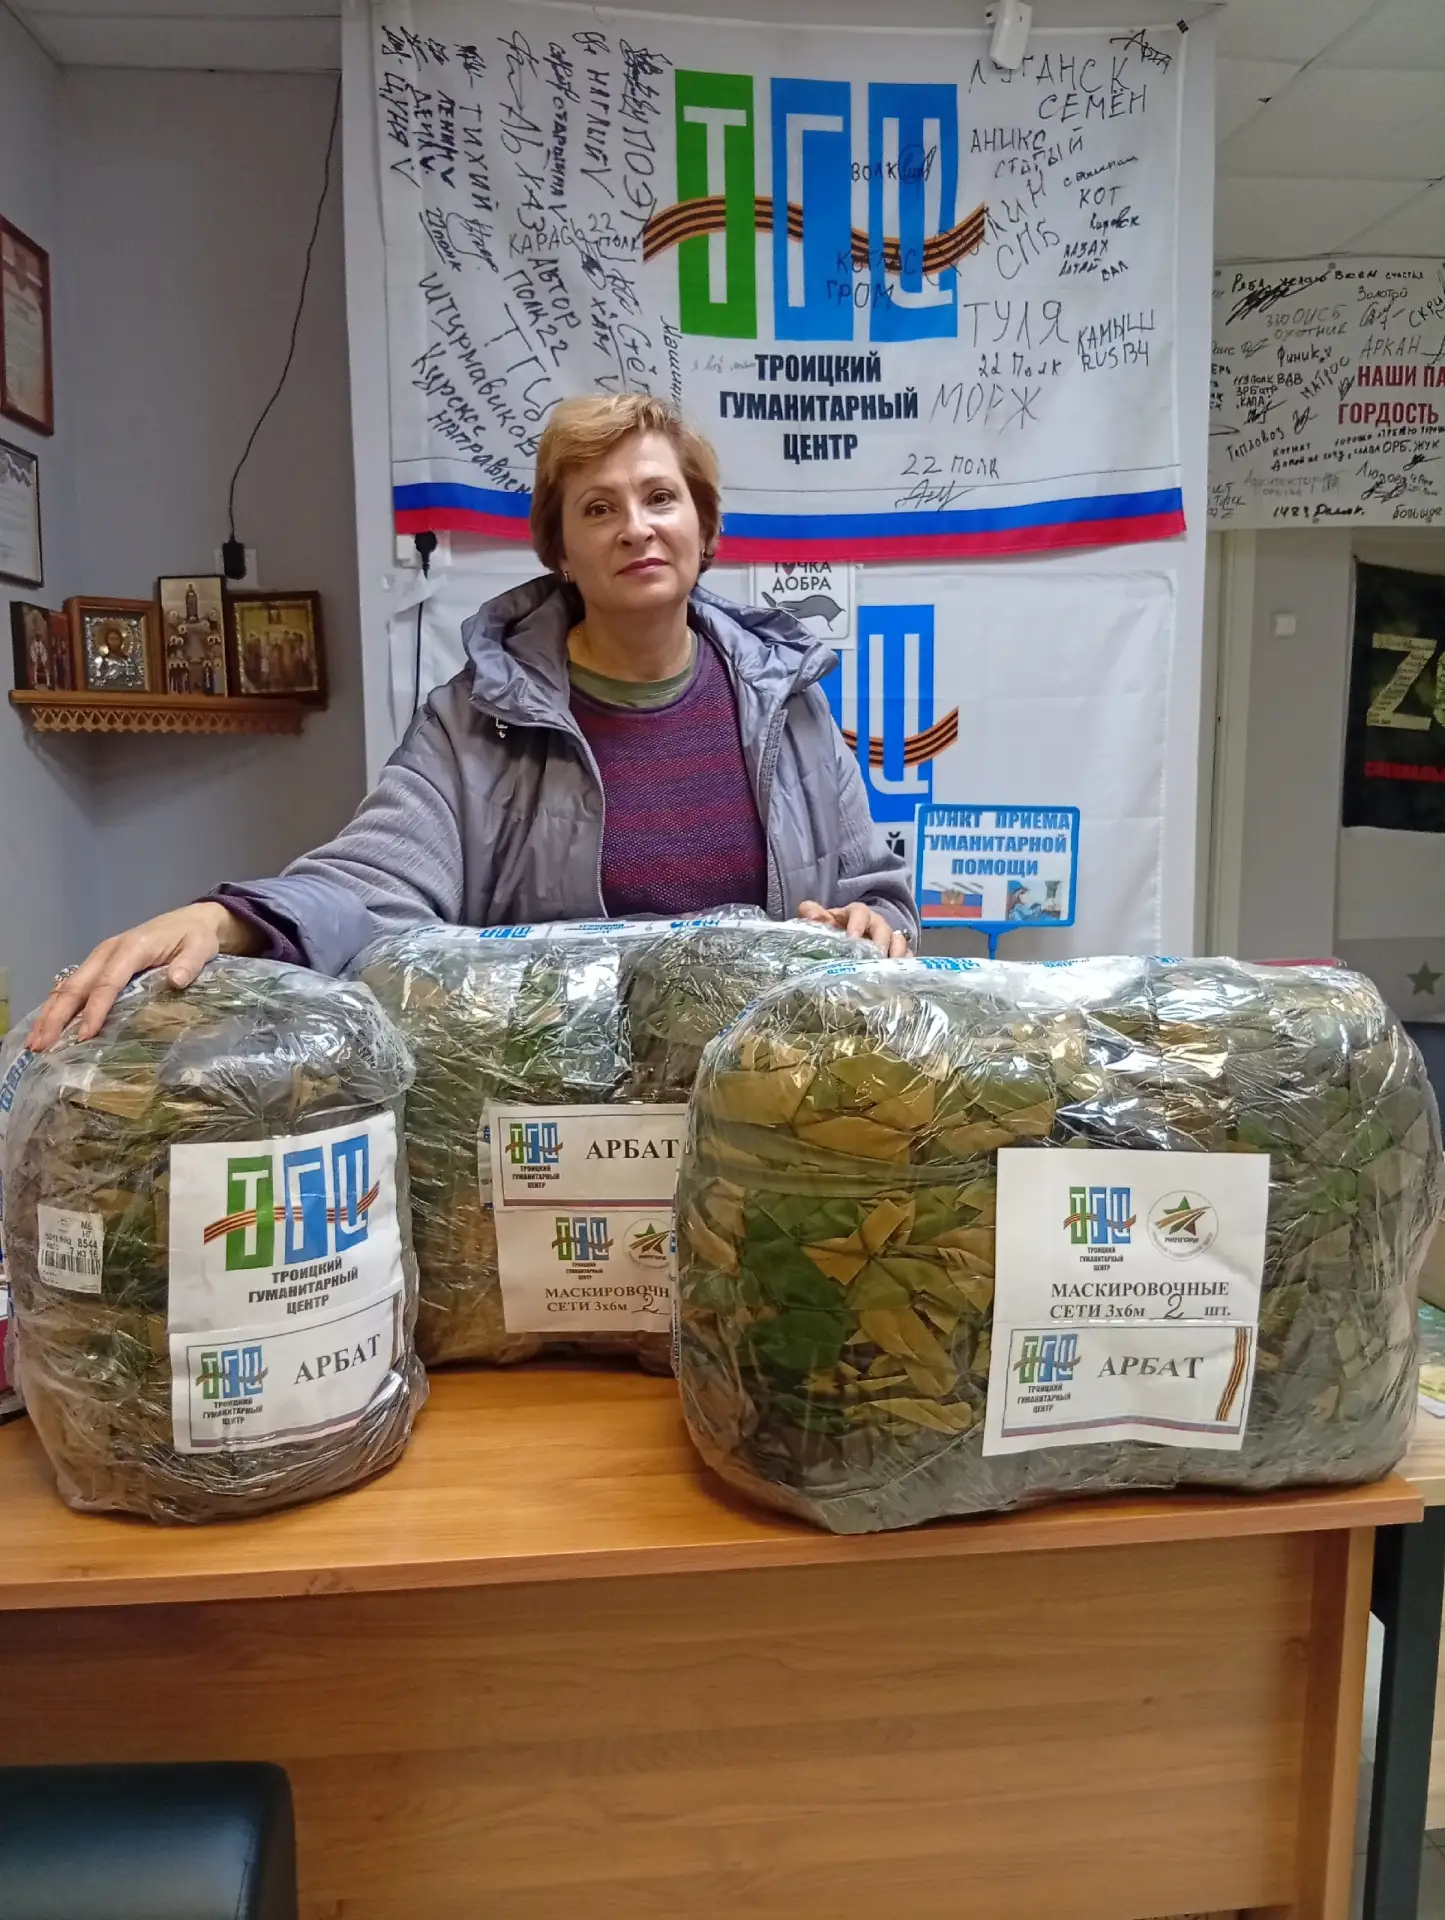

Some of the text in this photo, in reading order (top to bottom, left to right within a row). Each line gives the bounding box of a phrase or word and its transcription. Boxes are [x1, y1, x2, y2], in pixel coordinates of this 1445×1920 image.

[754, 351, 882, 386] ТРОИЦКИЙ
[1358, 366, 1417, 388] НАШИ
[719, 386, 919, 422] ГУМАНИТАРНЫЙ
[1338, 402, 1440, 426] ГОРДОСТЬ
[783, 433, 858, 465] ЦЕНТР
[900, 453, 943, 477] 22
[772, 576, 832, 594] ДОБРА
[995, 811, 1070, 830] ПРИЕМА
[951, 858, 1039, 878] ПОМОЩИ
[586, 1138, 679, 1160] АРБАТ
[271, 1257, 343, 1285] ТРОИЦКИЙ
[248, 1266, 360, 1304] ГУМАНИТАРНЫЙ
[1051, 1281, 1230, 1299] МАСКИРОВОЧНЫЕ
[286, 1293, 330, 1316] ЦЕНТР
[546, 1301, 590, 1313] СЕТИ
[1050, 1303, 1101, 1319] СЕТИ
[1163, 1293, 1185, 1320] 2
[293, 1332, 382, 1386] АРБАТ
[1097, 1355, 1205, 1380] АРБАТ
